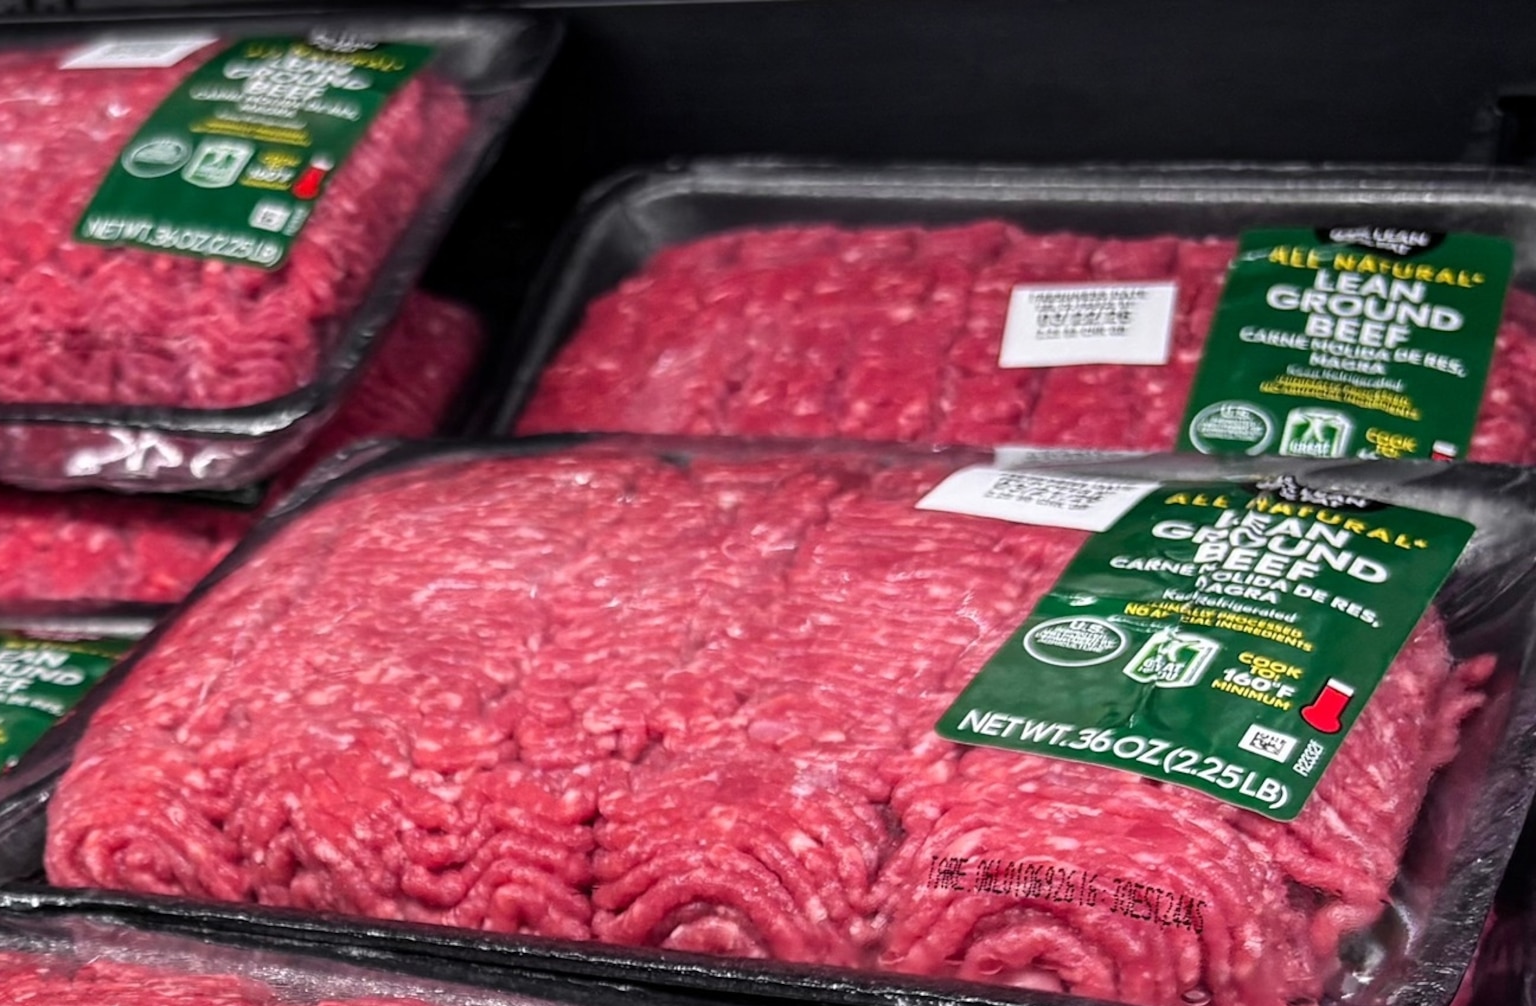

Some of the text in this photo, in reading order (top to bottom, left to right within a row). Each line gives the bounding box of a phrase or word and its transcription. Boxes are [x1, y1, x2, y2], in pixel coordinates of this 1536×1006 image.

[1313, 267, 1429, 304] LEAN
[1265, 282, 1465, 332] GROUND
[1304, 312, 1412, 350] BEEF
[1216, 509, 1351, 549] LEAN
[1151, 519, 1391, 584] GROUND
[1192, 541, 1323, 582] BEEF
[1109, 554, 1196, 576] CARNE
[1293, 583, 1327, 604] DE
[1330, 595, 1383, 629] RES,
[1124, 603, 1150, 618] NO
[1238, 651, 1304, 680] COOK
[1211, 679, 1293, 713] MINIMUM
